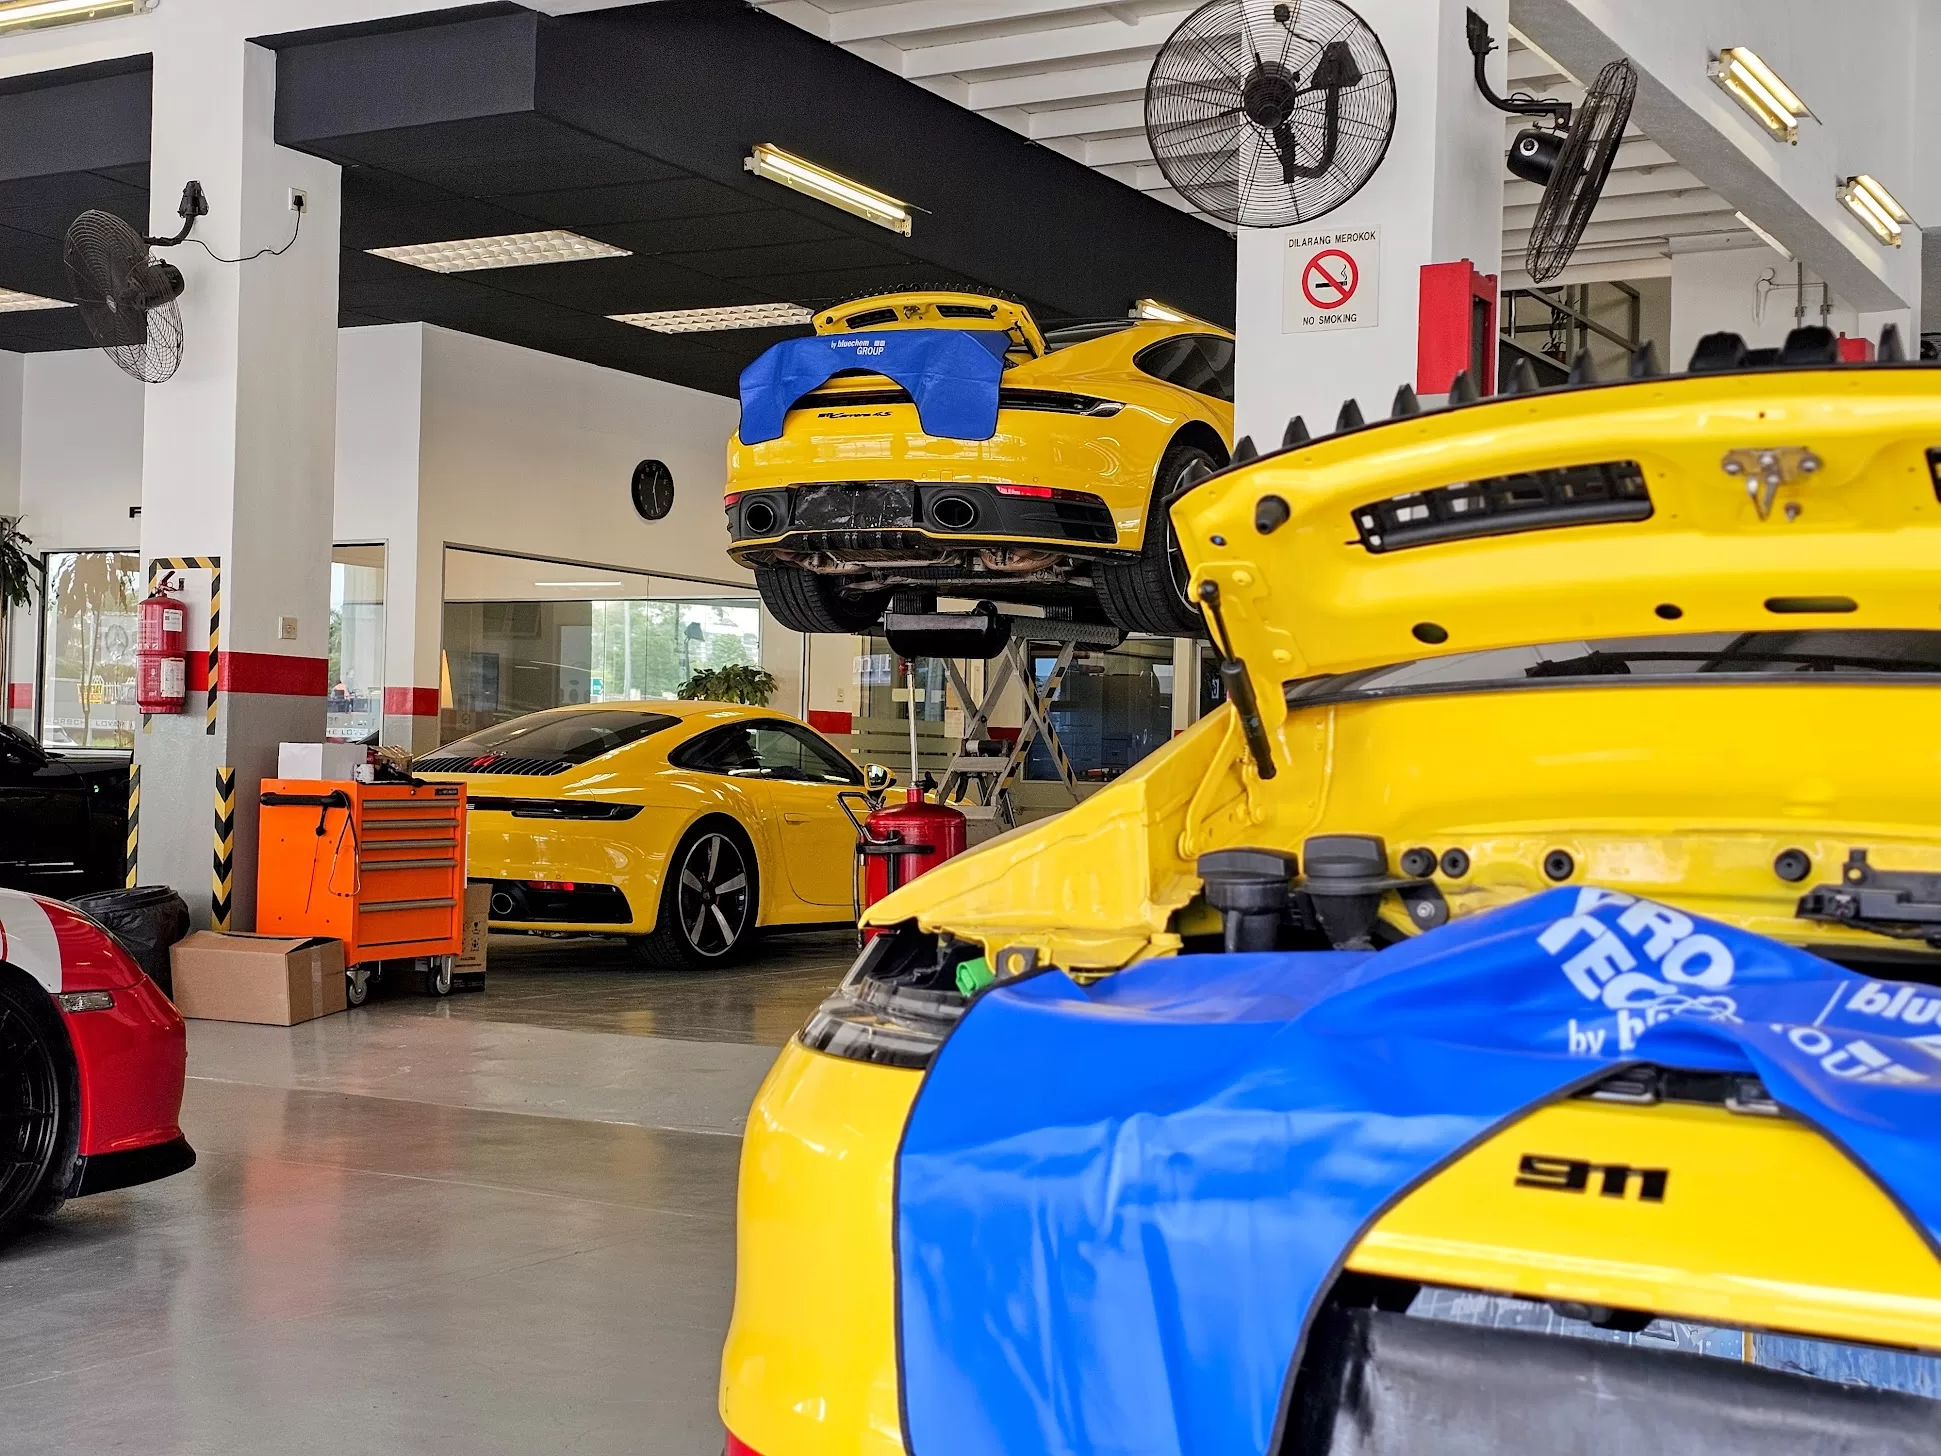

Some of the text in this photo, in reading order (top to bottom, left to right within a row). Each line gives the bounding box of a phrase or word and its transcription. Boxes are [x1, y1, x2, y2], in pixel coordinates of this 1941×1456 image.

[1288, 231, 1376, 248] DILARANG MEROKOK
[1303, 313, 1357, 326] NO SMOKING
[831, 340, 837, 349] by
[857, 347, 884, 355] GROUP
[1845, 980, 1941, 1028] blu
[1568, 1018, 1606, 1056] by
[1514, 1152, 1669, 1204] 911
